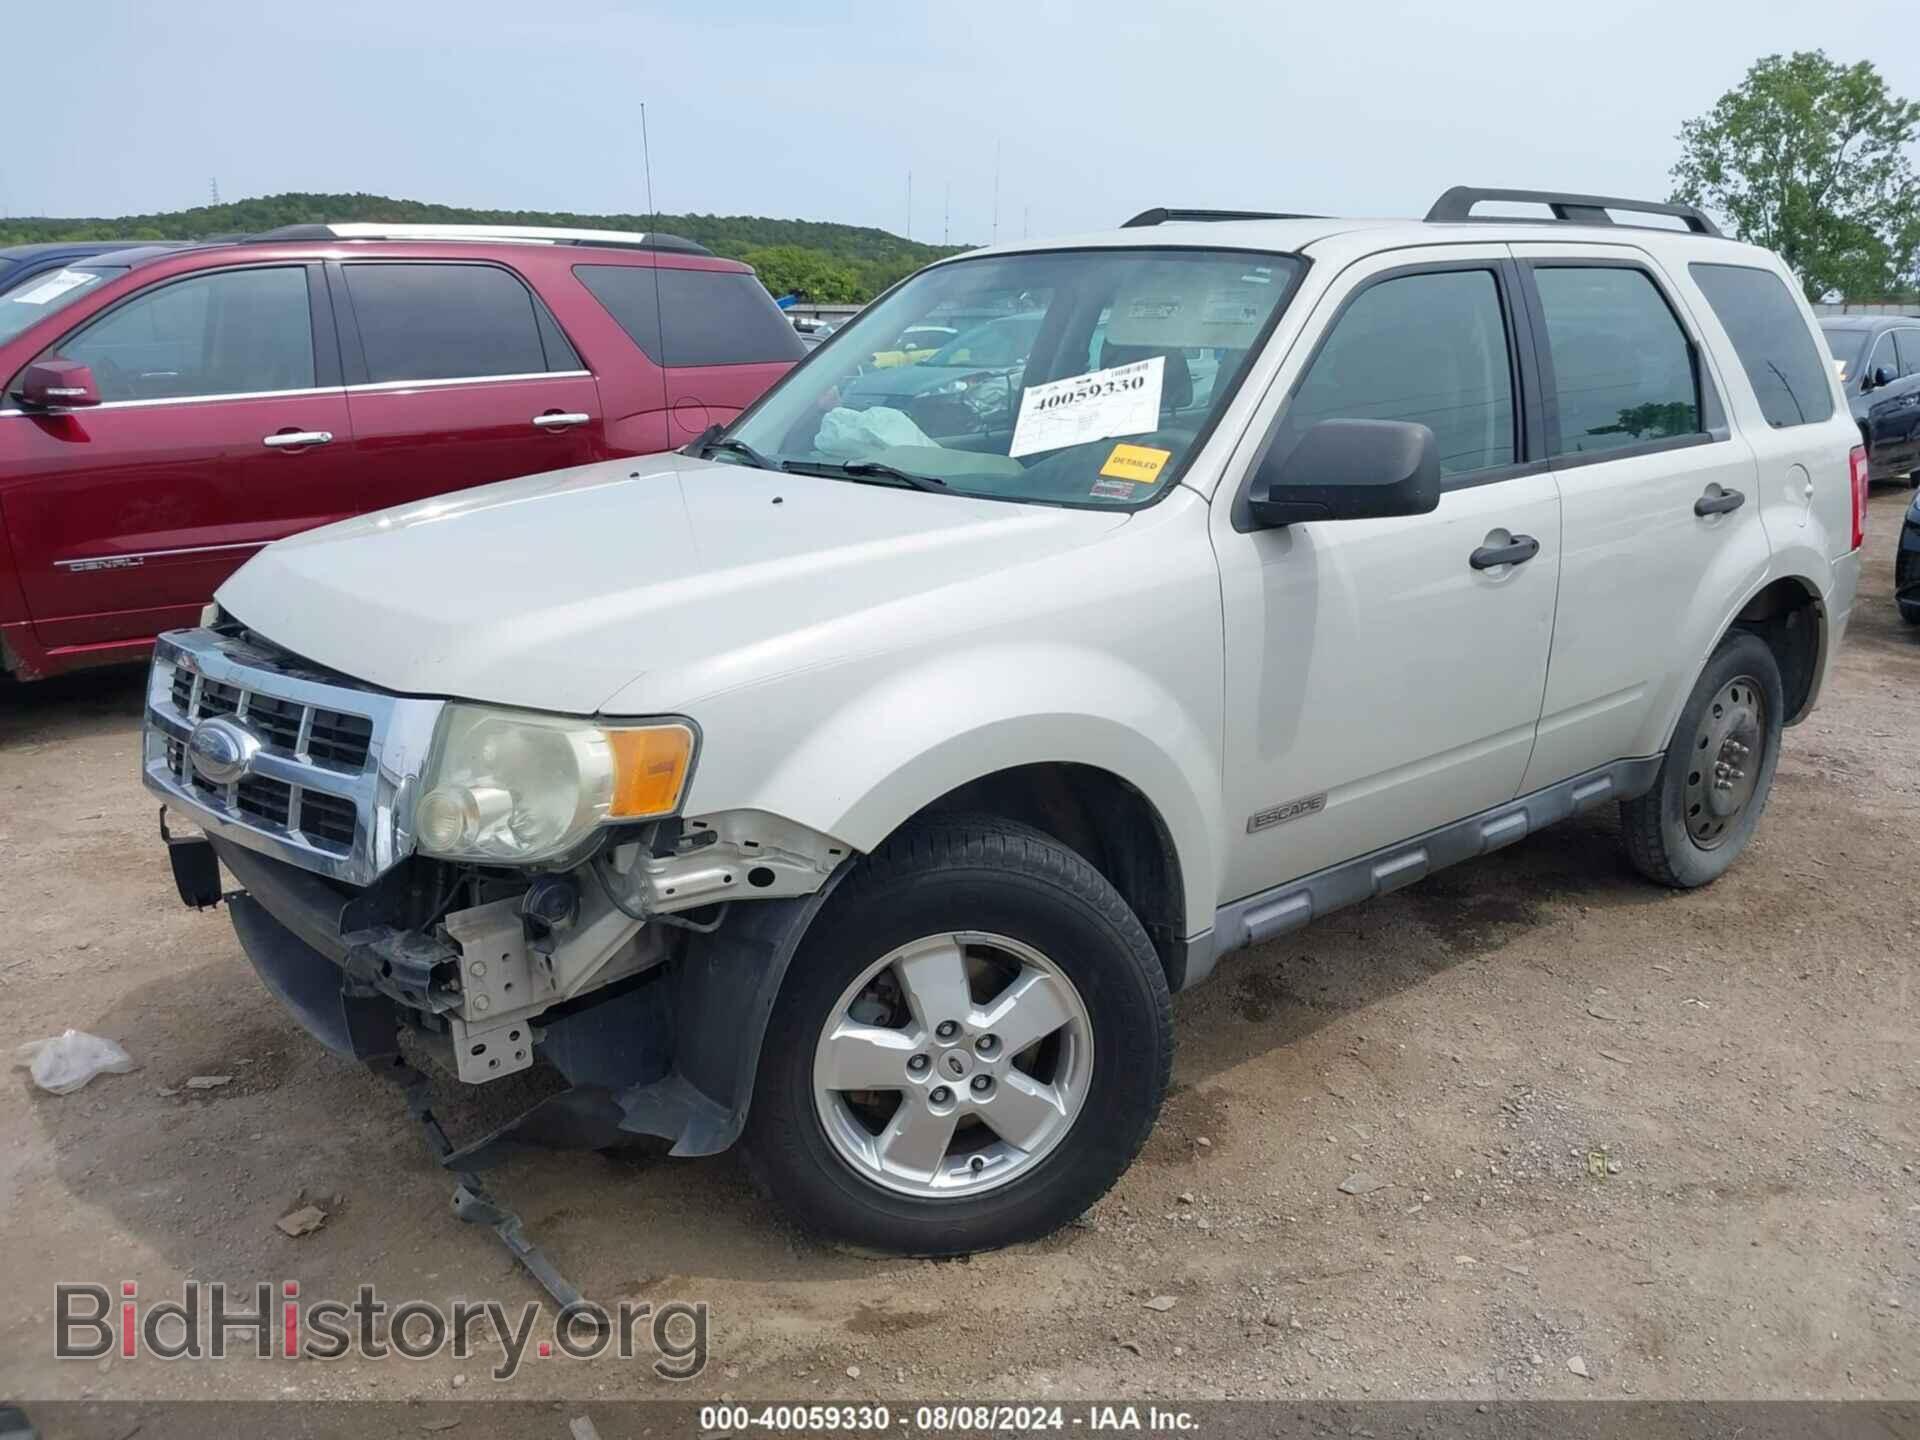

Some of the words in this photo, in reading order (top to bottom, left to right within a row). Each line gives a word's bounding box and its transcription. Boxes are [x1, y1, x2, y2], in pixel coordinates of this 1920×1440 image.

[1033, 376, 1145, 411] 40059330
[1113, 456, 1158, 470] DETAILED
[70, 557, 144, 572] DENALI
[1255, 797, 1321, 827] ESCAPE
